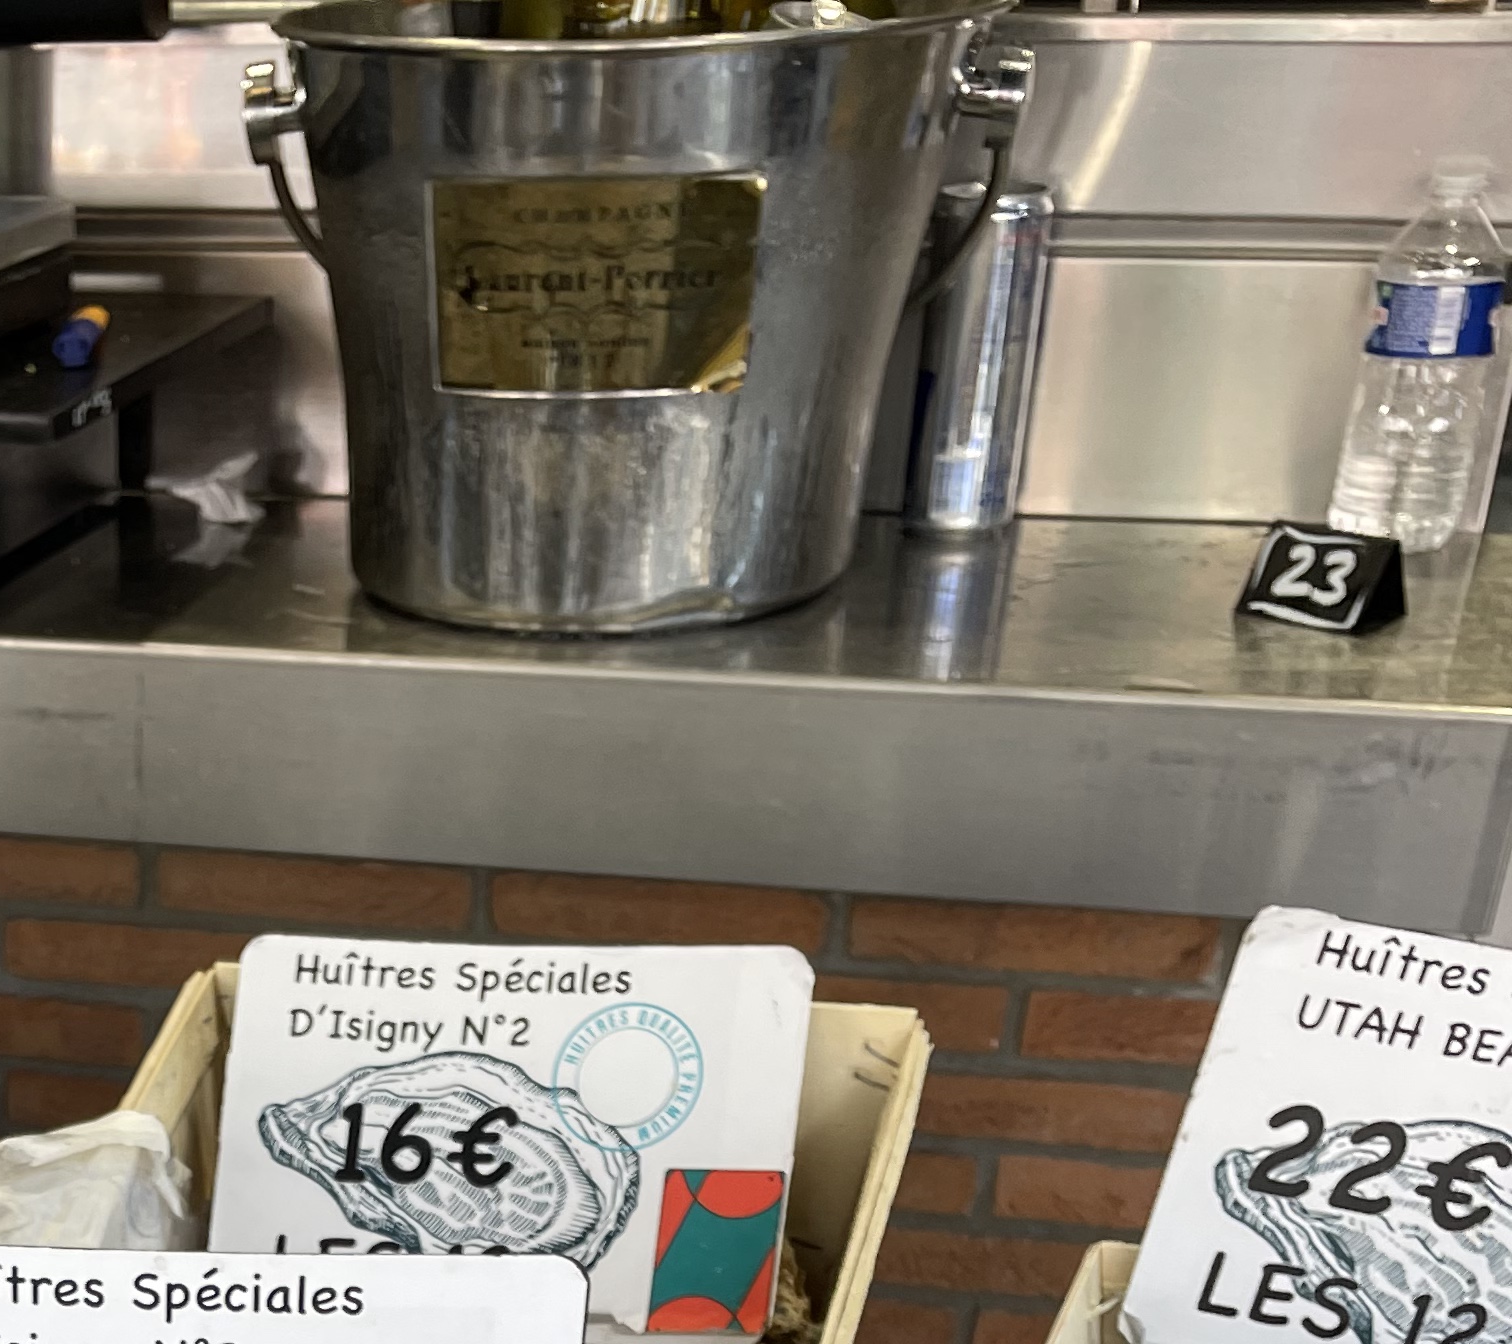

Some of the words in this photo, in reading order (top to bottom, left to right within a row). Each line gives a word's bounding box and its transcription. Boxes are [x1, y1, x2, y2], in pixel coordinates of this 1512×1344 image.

[1273, 542, 1360, 607] 23
[295, 952, 435, 992] Huîtres
[456, 957, 633, 1001] Spéciales
[1315, 929, 1491, 996] Huîtres
[289, 1004, 445, 1051] D'Isigny
[1298, 994, 1425, 1052] UTAH
[132, 1268, 365, 1322] Spéciales
[1197, 1251, 1358, 1339] LES
